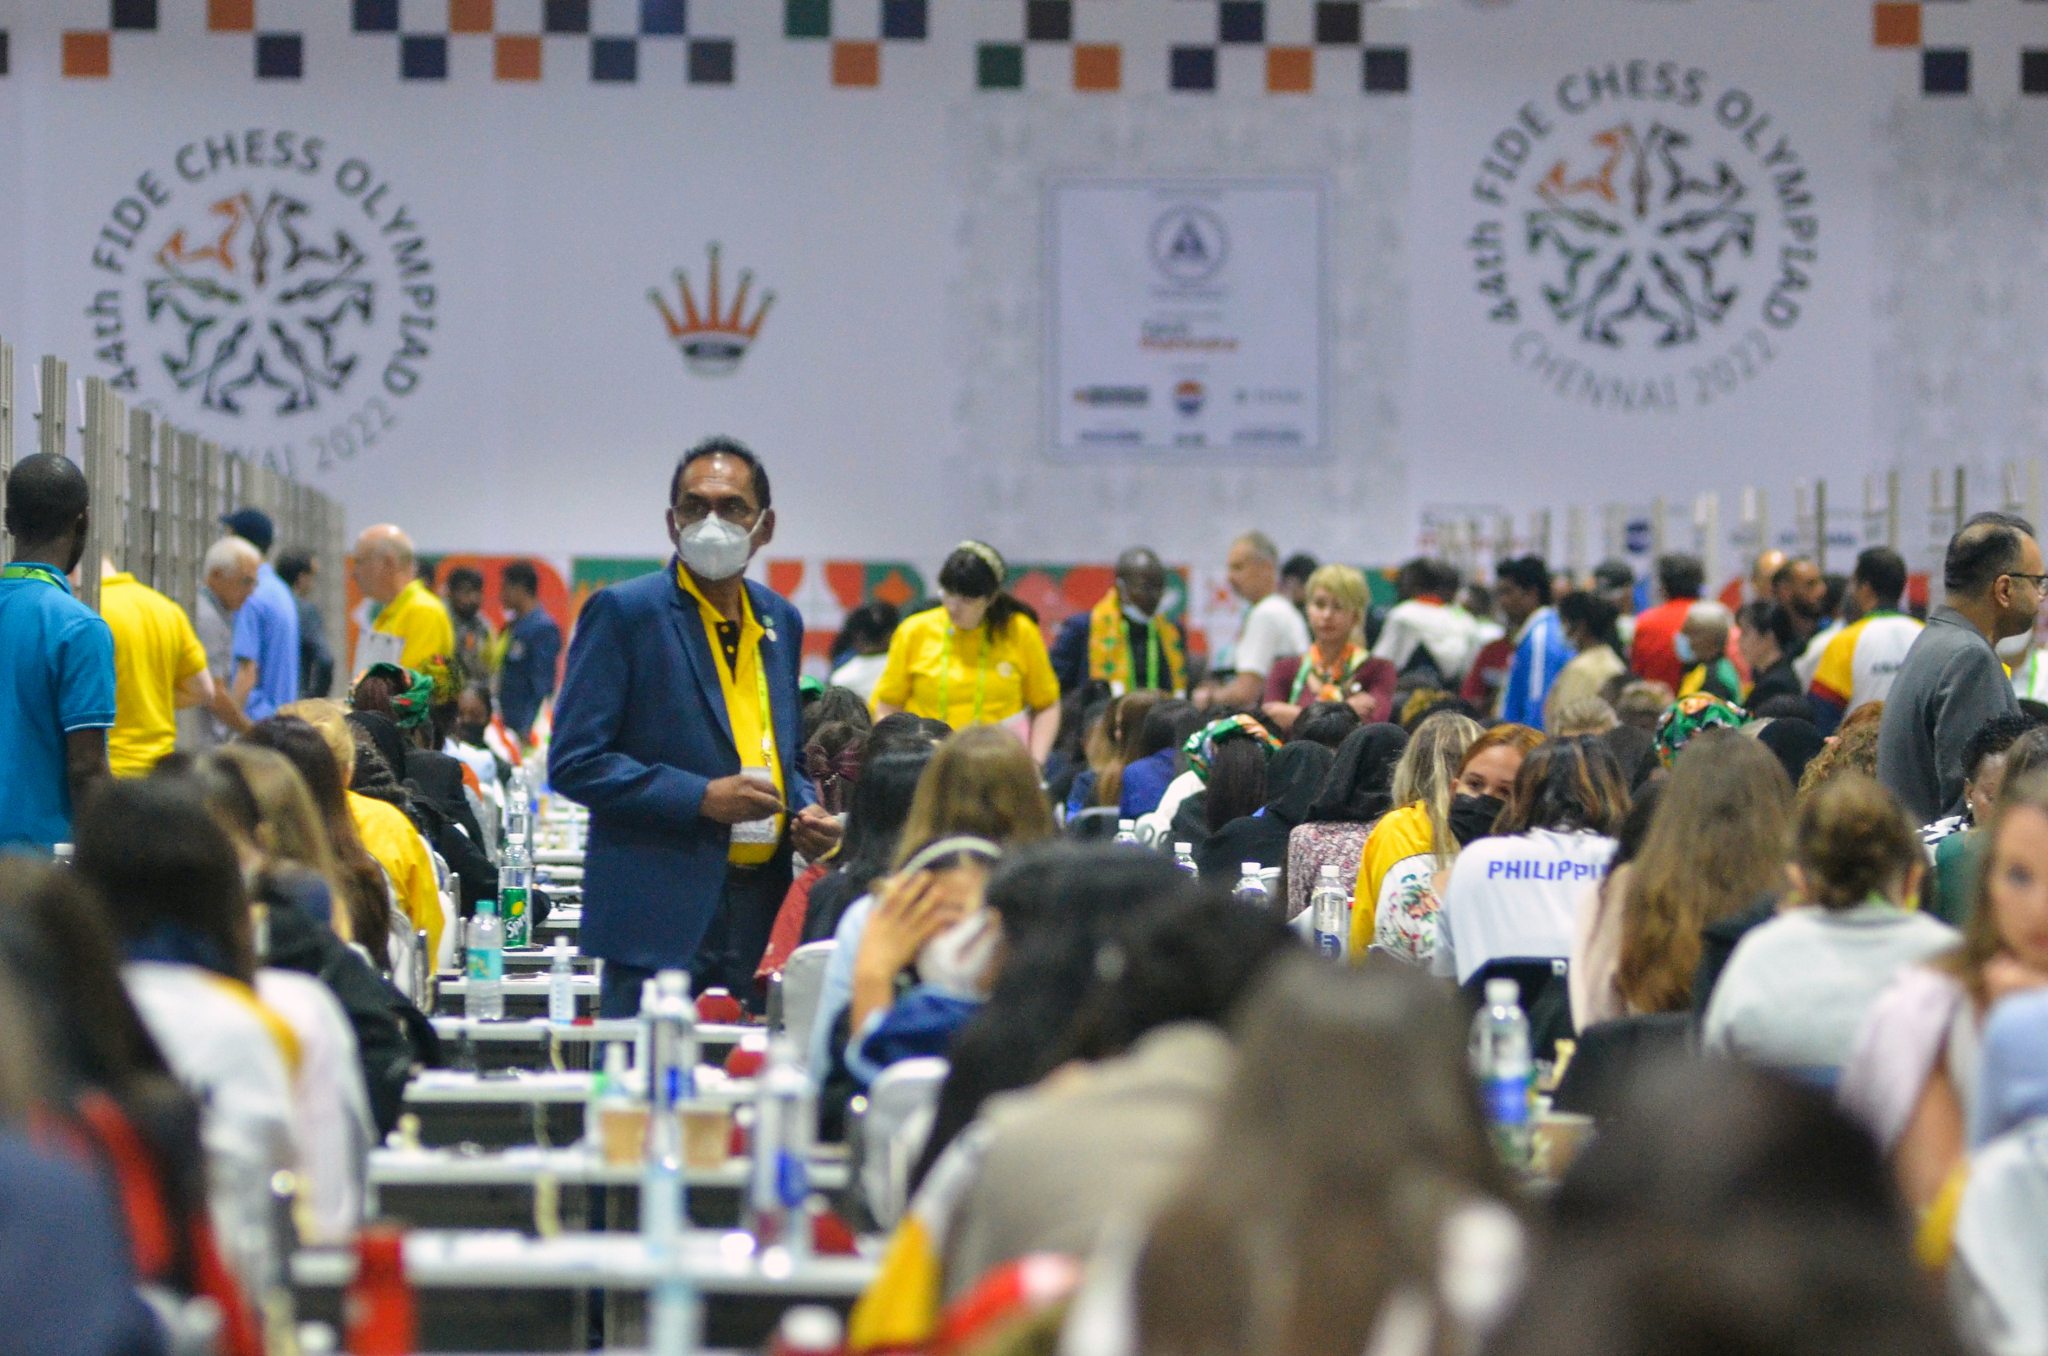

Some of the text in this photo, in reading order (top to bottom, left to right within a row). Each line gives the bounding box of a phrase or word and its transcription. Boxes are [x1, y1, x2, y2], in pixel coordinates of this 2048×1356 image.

[86, 128, 438, 397] 44th FIDE CHESS OLYMPIAD
[1466, 59, 1820, 330] 44th FIDE CHESS OLYMPIAD
[310, 397, 397, 471] 2022
[1510, 329, 1776, 413] CHENNAI 2022
